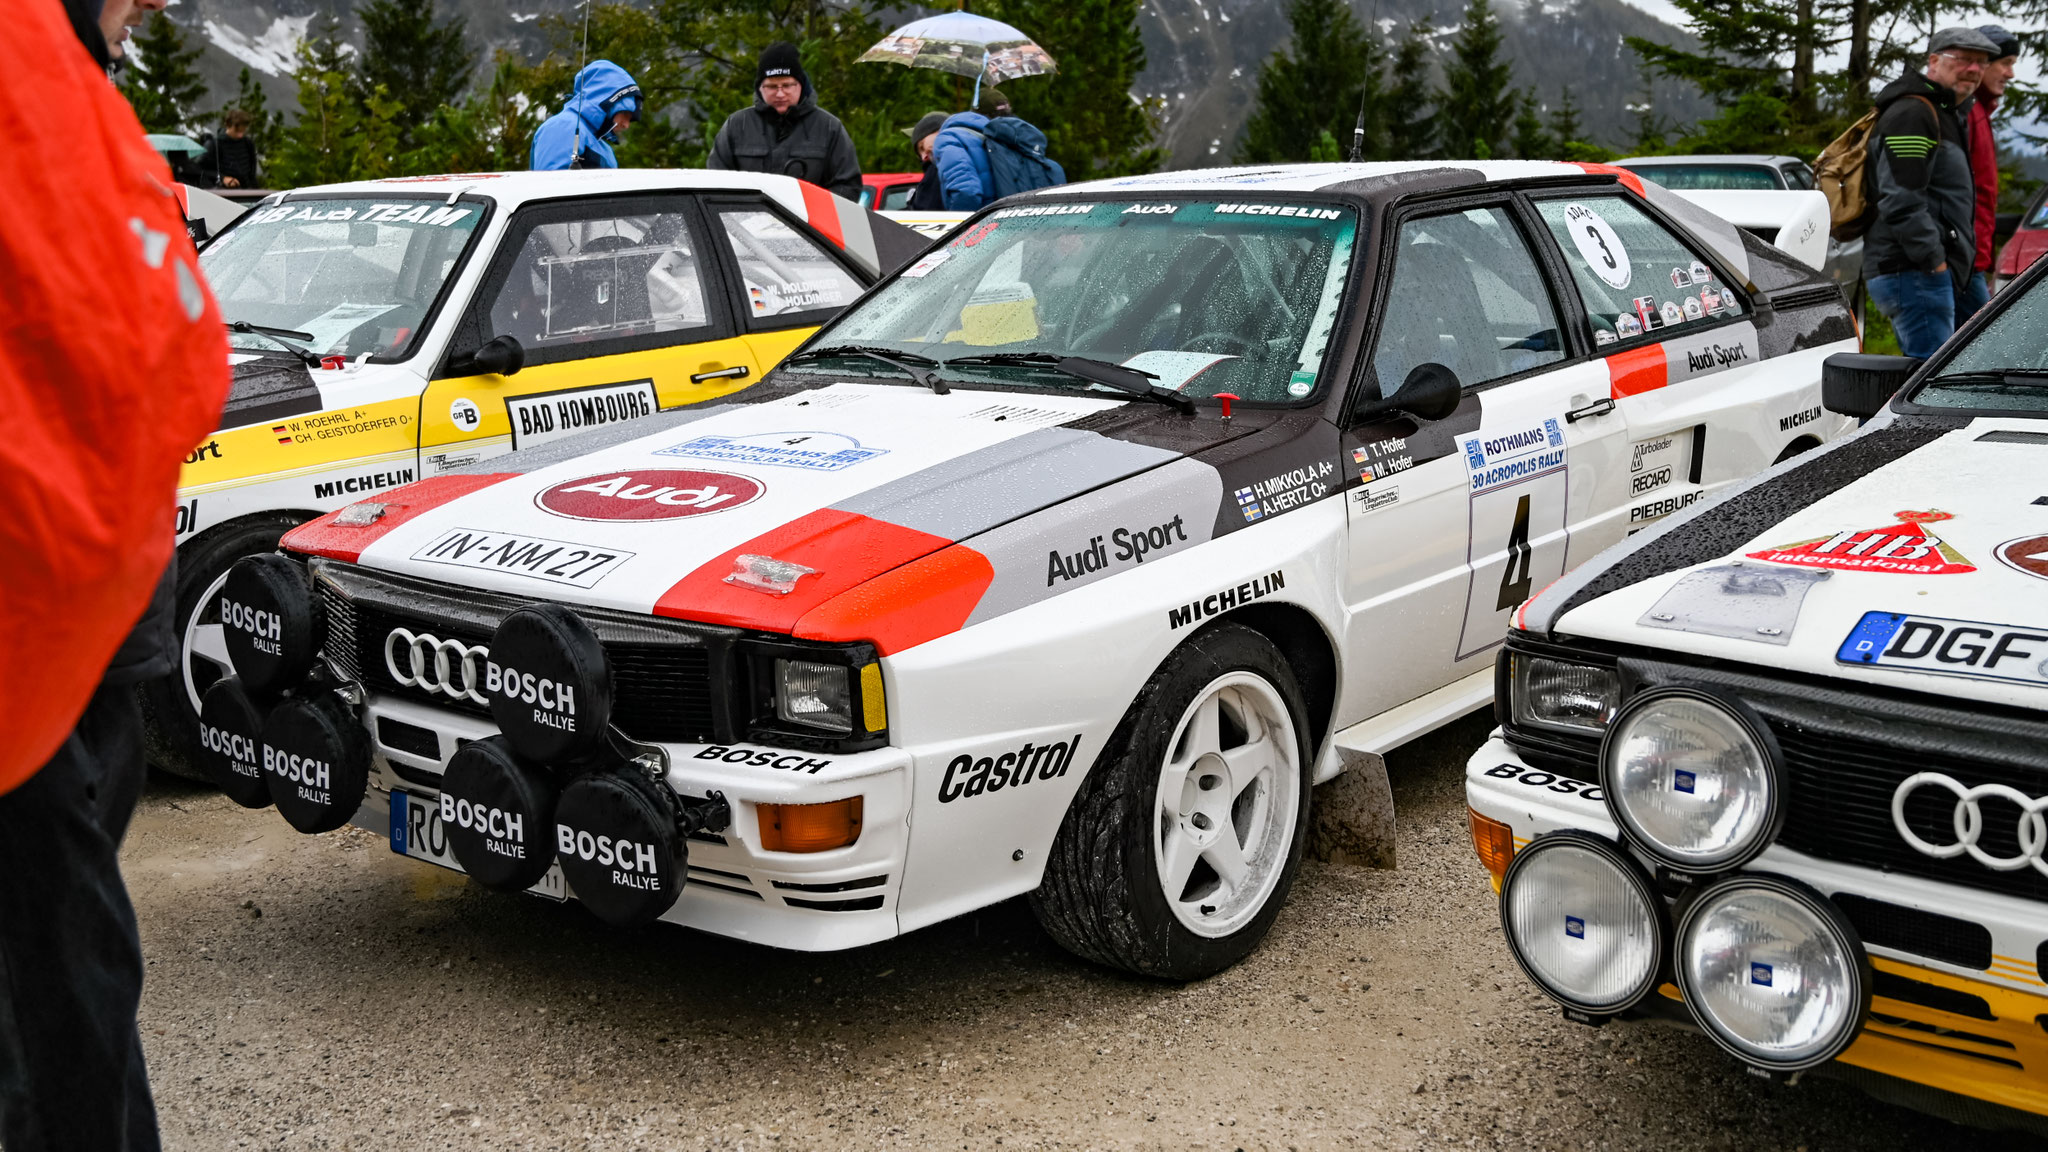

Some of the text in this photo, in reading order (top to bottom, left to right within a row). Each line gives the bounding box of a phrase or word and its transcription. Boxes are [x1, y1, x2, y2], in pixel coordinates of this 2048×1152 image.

[238, 204, 472, 228] HB Audi TEAM
[993, 205, 1094, 220] MICHELIN
[1121, 204, 1179, 215] Audi
[1214, 203, 1341, 220] MICHELIN
[1567, 206, 1593, 222] ADAC
[1585, 225, 1617, 270] 3
[785, 291, 842, 306] HOLDINGER
[1687, 341, 1748, 372] Audi Sport
[288, 422, 304, 433] W.
[305, 412, 350, 430] ROEHRL
[463, 408, 478, 424] B
[518, 390, 650, 436] BAD HOMBOURG
[1779, 405, 1822, 432] MICHELIN
[295, 431, 316, 444] CH.
[318, 416, 398, 440] GEISTDOERFER
[1484, 427, 1545, 457] ROTHMANS
[182, 440, 223, 464] ort
[687, 448, 780, 464] ACROPOLIS
[783, 456, 843, 469] RALLY
[718, 444, 827, 458] ROTHMANS
[1370, 437, 1407, 458] T. Hofer
[1640, 438, 1672, 455] Turbolader
[1374, 455, 1414, 479] M. Hofer
[1472, 449, 1564, 489] 30 ACROPOLIS RALLY
[1632, 467, 1671, 494] RECARO
[314, 468, 414, 499] MICHELIN
[566, 475, 736, 508] Audi
[426, 533, 617, 579] IN-NM 27
[1047, 514, 1187, 587] Audi Sport
[1811, 530, 1942, 559] HB
[1496, 494, 1532, 627] 4
[1768, 552, 1945, 573] international
[1168, 570, 1285, 630] MICHELIN
[221, 597, 281, 641] BOSCH
[253, 636, 282, 656] RALLYE
[1855, 620, 2048, 668] D DGF
[485, 661, 575, 715] BOSCH
[534, 709, 576, 732] RALLYE
[200, 722, 257, 764] BOSCH
[232, 761, 260, 778] RALLYE
[263, 744, 330, 790] BOSCH
[694, 745, 833, 775] BOSCH
[938, 734, 1082, 803] Castrol
[1484, 763, 1605, 800] BOSC
[298, 786, 332, 805] RALLYE
[440, 792, 523, 842] BOSCH
[486, 838, 526, 859] RALLYE
[557, 823, 657, 874] BOSCH
[613, 870, 661, 890] RALLYE
[1669, 872, 1693, 884] Hella
